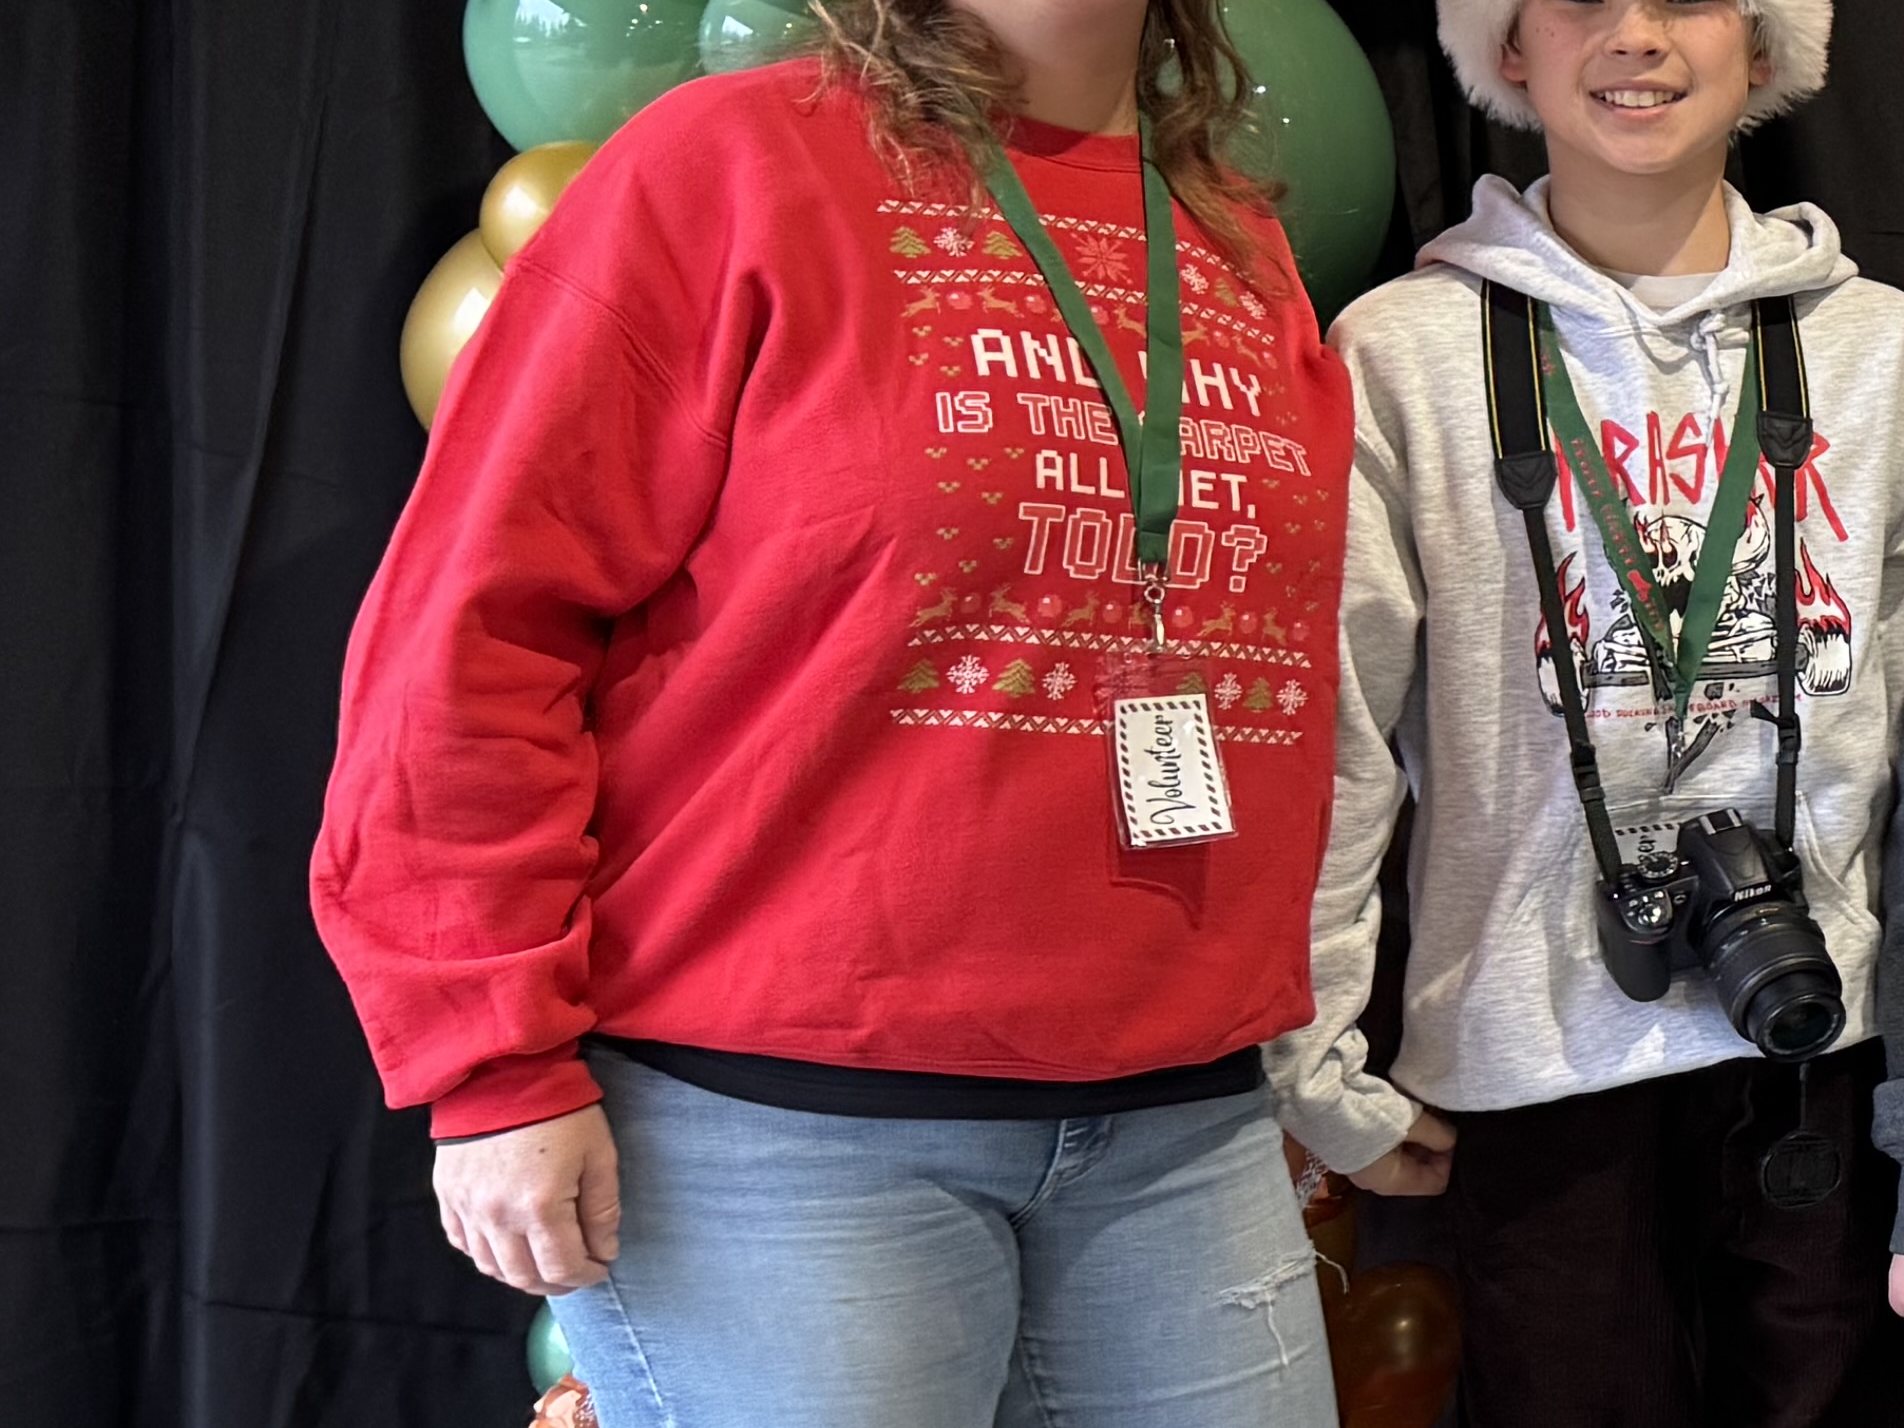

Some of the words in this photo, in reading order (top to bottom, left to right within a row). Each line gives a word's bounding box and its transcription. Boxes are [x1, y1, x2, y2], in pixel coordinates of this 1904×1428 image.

[1138, 350, 1264, 418] HY
[936, 391, 994, 433] IS
[1017, 393, 1119, 446] THE
[1138, 411, 1312, 476] ARPET
[1036, 449, 1125, 499] ALL
[1178, 469, 1257, 519] ET,
[1019, 502, 1268, 593] TOLD?
[1143, 714, 1196, 826] Volunteer
[1734, 884, 1772, 902] Nikon
